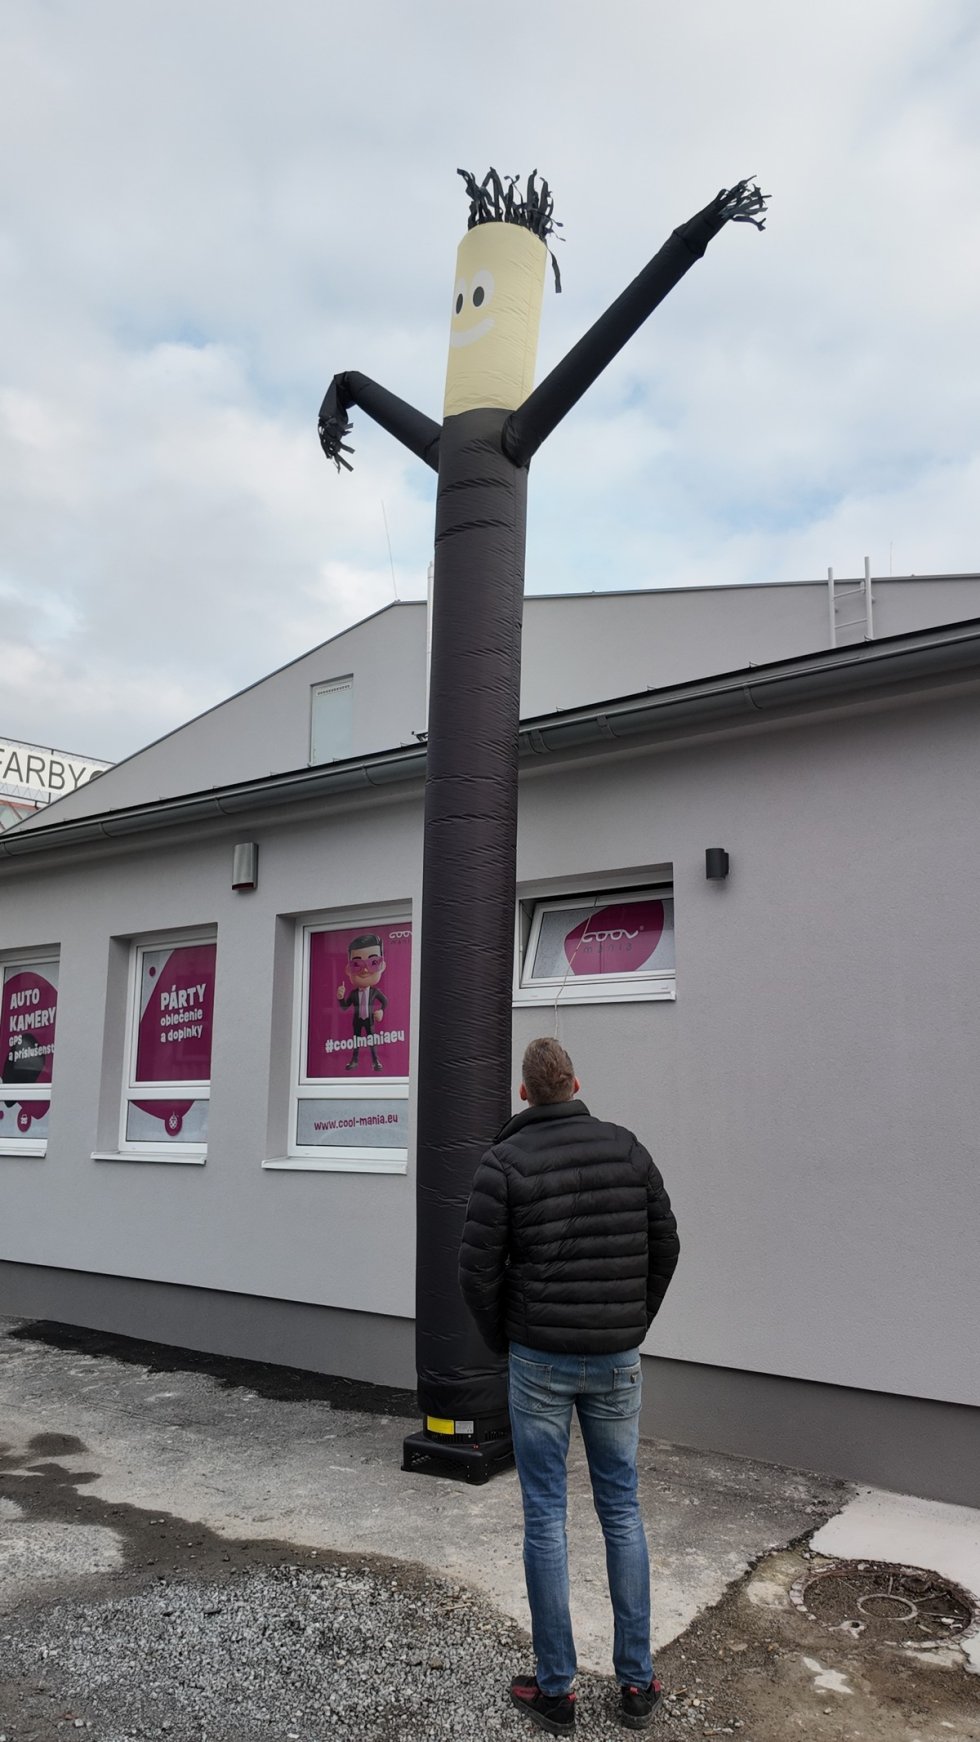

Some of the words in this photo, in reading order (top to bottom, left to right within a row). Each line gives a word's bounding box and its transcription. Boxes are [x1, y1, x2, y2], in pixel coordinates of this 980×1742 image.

[0, 748, 86, 790] ARBY
[10, 988, 40, 1010] AUTO
[160, 983, 206, 1011] PÁRTY
[9, 1006, 57, 1032] KAMERY
[160, 1009, 203, 1027] oblečenie
[8, 1034, 23, 1048] GPS
[160, 1032, 167, 1043] a
[167, 1024, 203, 1042] doplnky
[325, 1030, 405, 1053] #coolmaniaeu
[8, 1051, 14, 1062] a
[313, 1113, 399, 1131] www.cool-mania.eu
